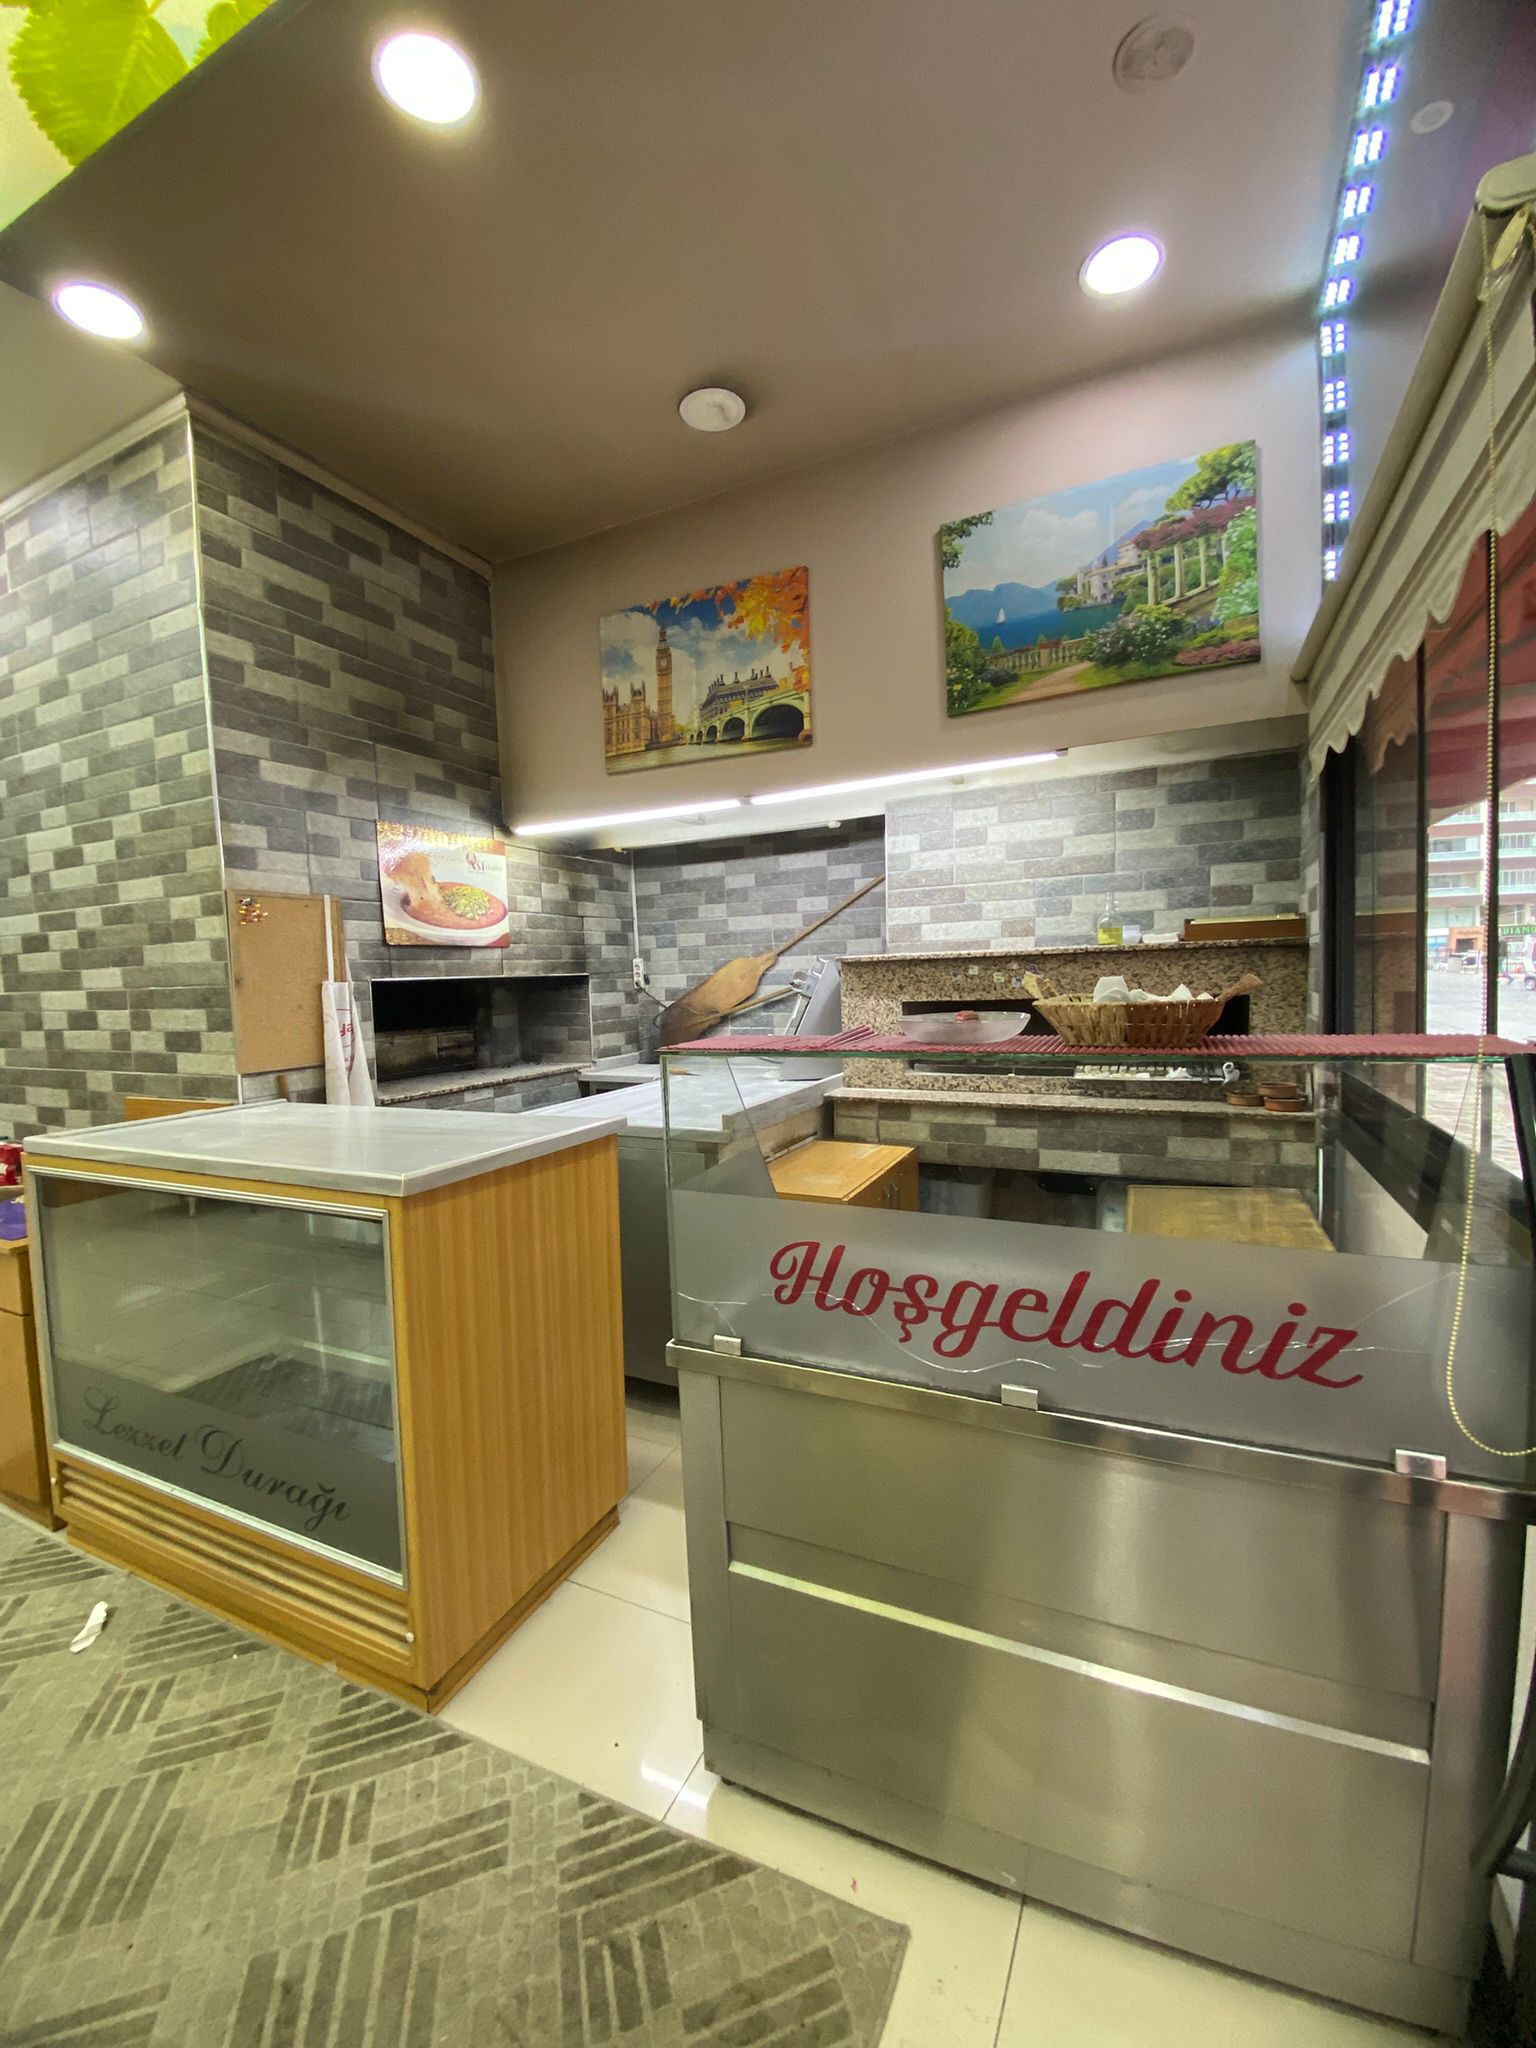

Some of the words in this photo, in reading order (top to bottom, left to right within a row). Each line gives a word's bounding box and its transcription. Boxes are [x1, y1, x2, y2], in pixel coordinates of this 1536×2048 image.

[770, 1241, 1363, 1388] Hoşgeldiniz
[83, 1387, 187, 1461] Lezzet
[199, 1424, 350, 1531] Durağı
